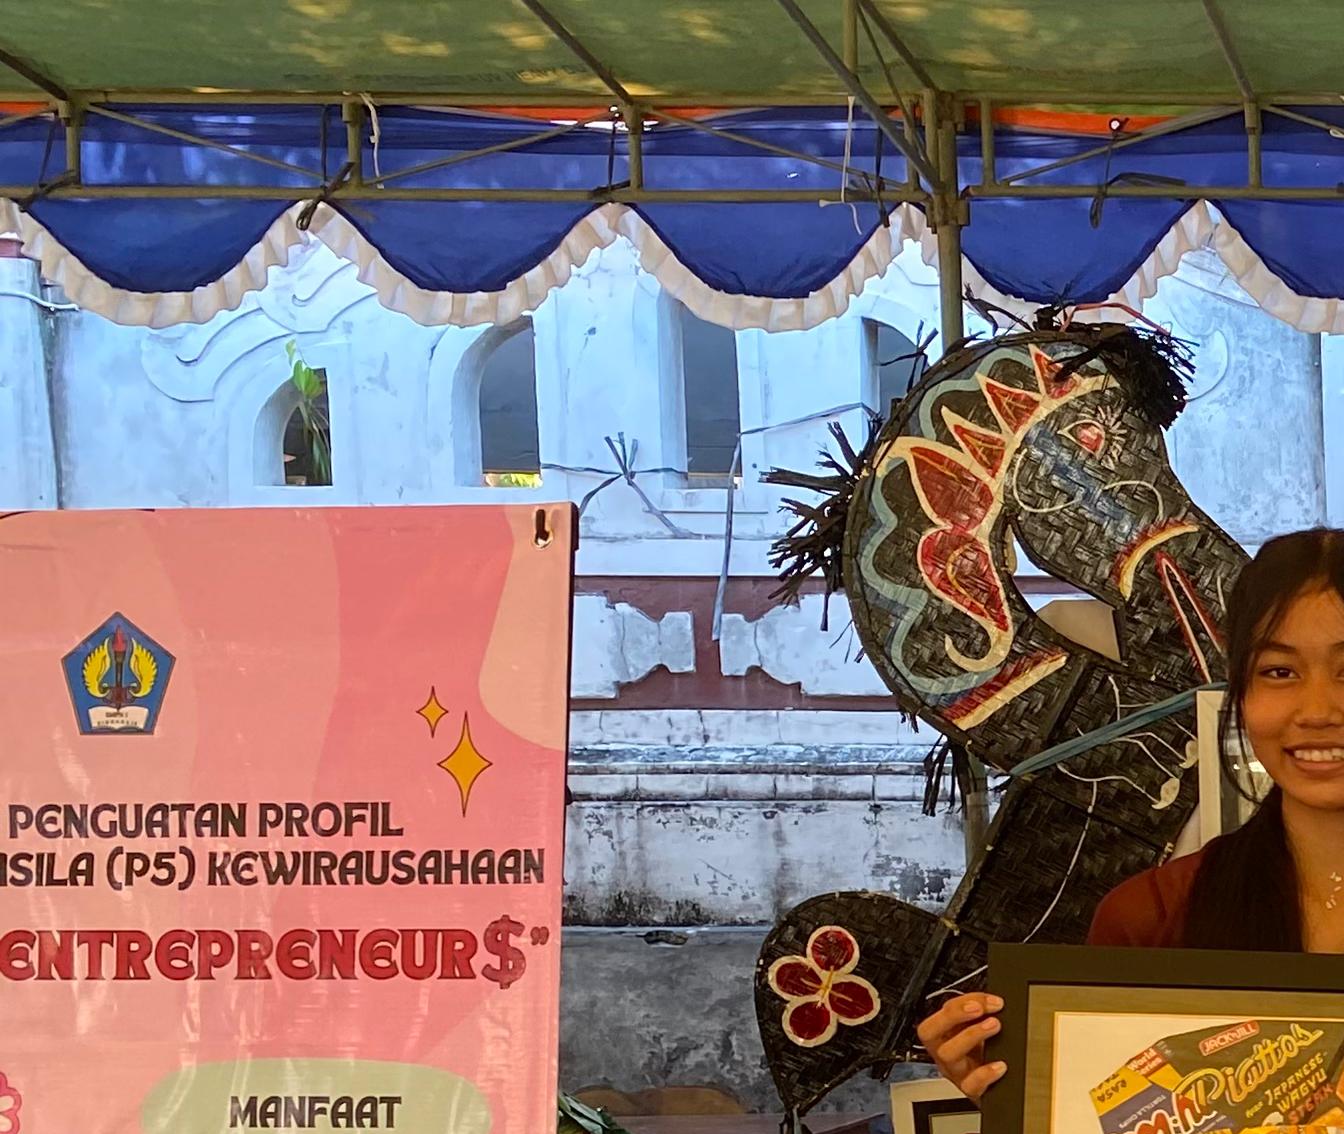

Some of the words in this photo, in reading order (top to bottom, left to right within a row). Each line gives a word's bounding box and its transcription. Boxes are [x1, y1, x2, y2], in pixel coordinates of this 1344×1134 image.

[9, 803, 247, 839] PENGUATAN
[259, 801, 403, 838] PROFIL
[107, 847, 195, 890] (P5)
[208, 849, 544, 884] KEWIRAUSAHAAN
[1173, 1023, 1323, 1105] Piattos
[230, 1095, 402, 1128] MANFAAT
